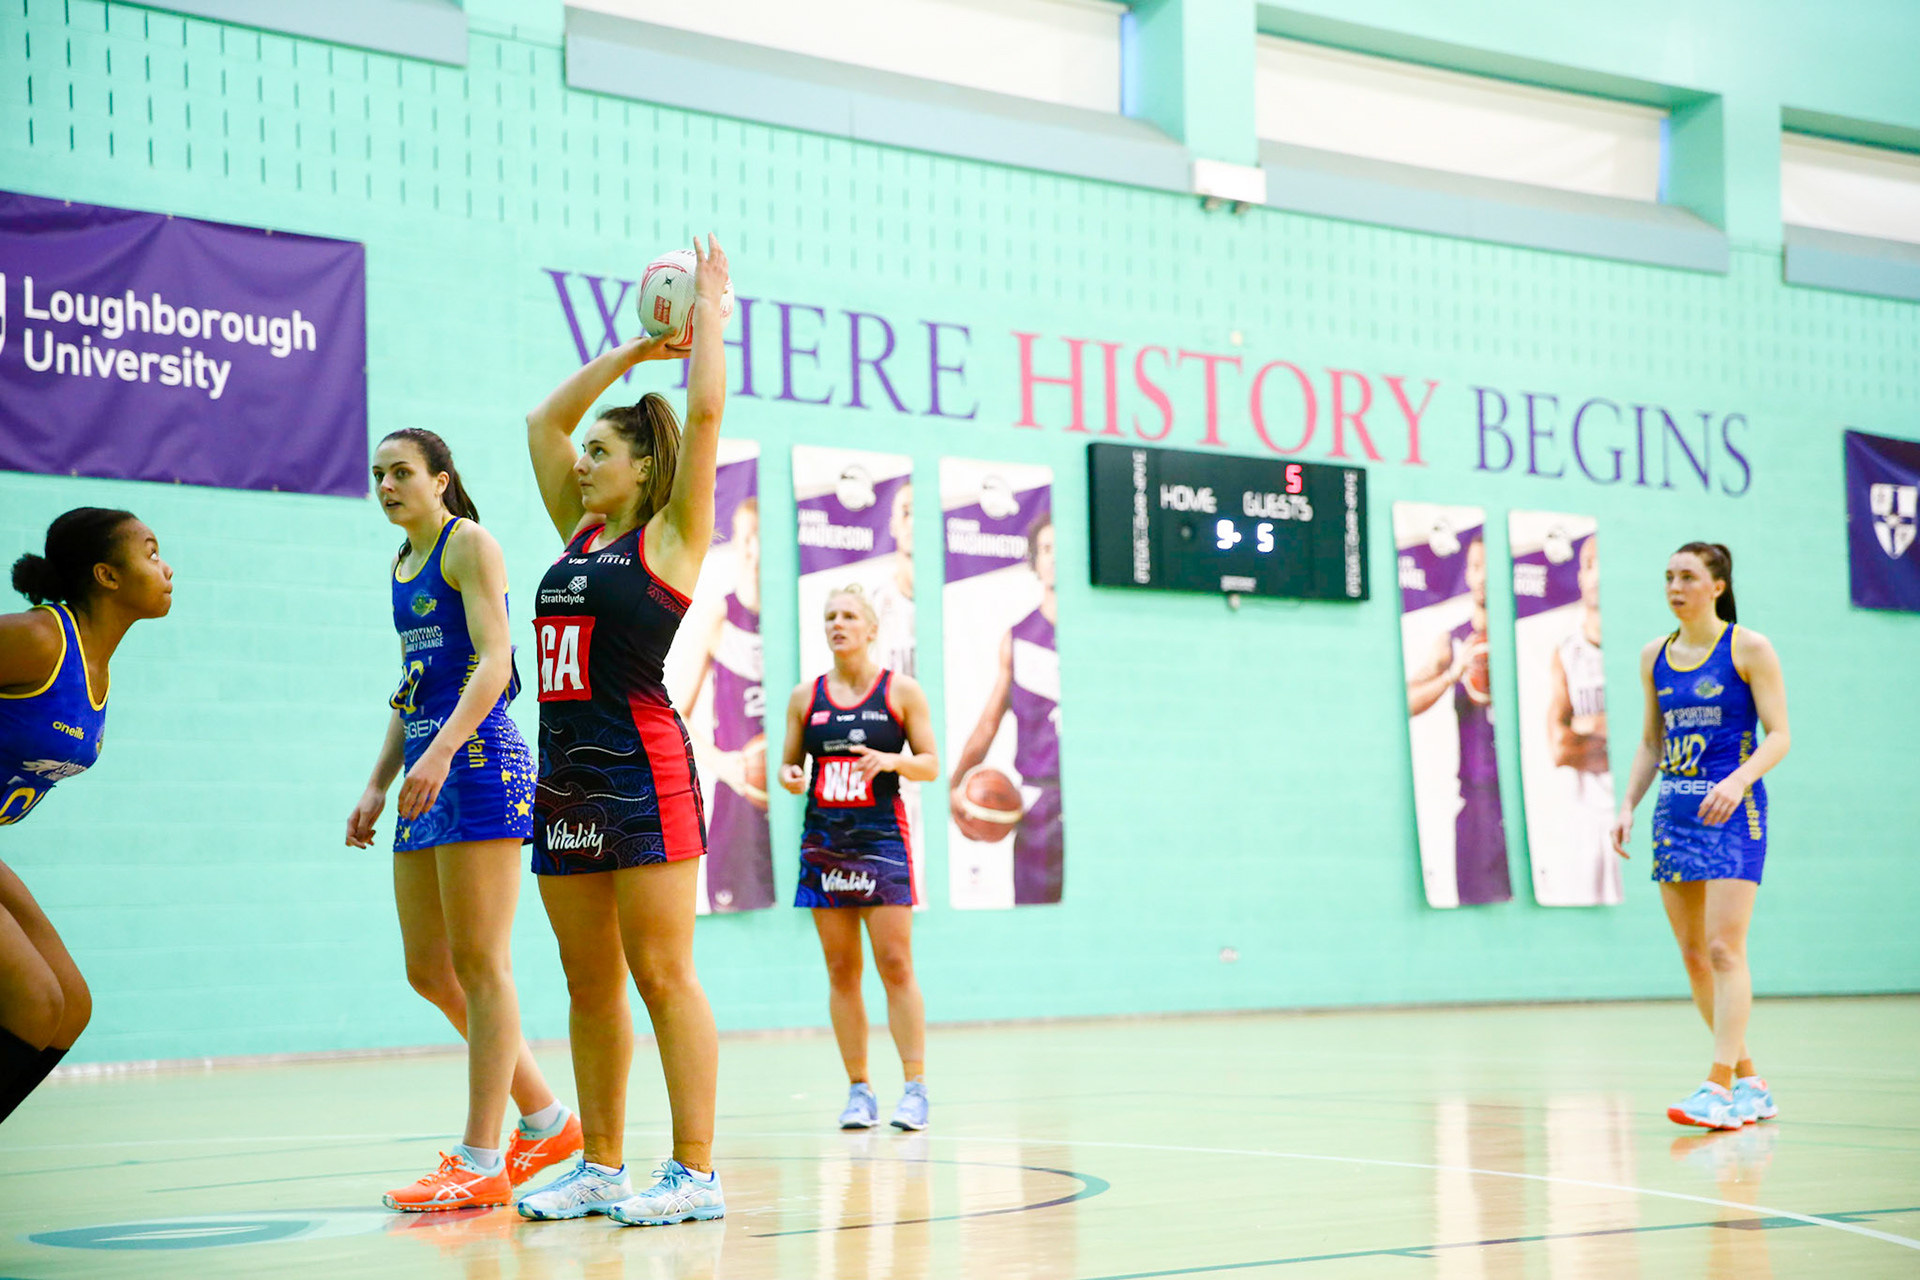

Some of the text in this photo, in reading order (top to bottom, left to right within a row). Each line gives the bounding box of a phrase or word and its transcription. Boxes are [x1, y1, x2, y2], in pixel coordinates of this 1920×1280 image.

[24, 277, 317, 358] Loughborough
[24, 329, 232, 400] University
[542, 267, 1753, 498] WHERE HISTORY BEGINS
[1285, 463, 1302, 493] 5
[1159, 483, 1313, 522] HOME GUESTS
[1257, 523, 1274, 552] 5
[541, 594, 585, 605] Strathclyde
[541, 624, 584, 693] GA
[546, 818, 604, 857] Vitality
[821, 868, 877, 897] Vitality
